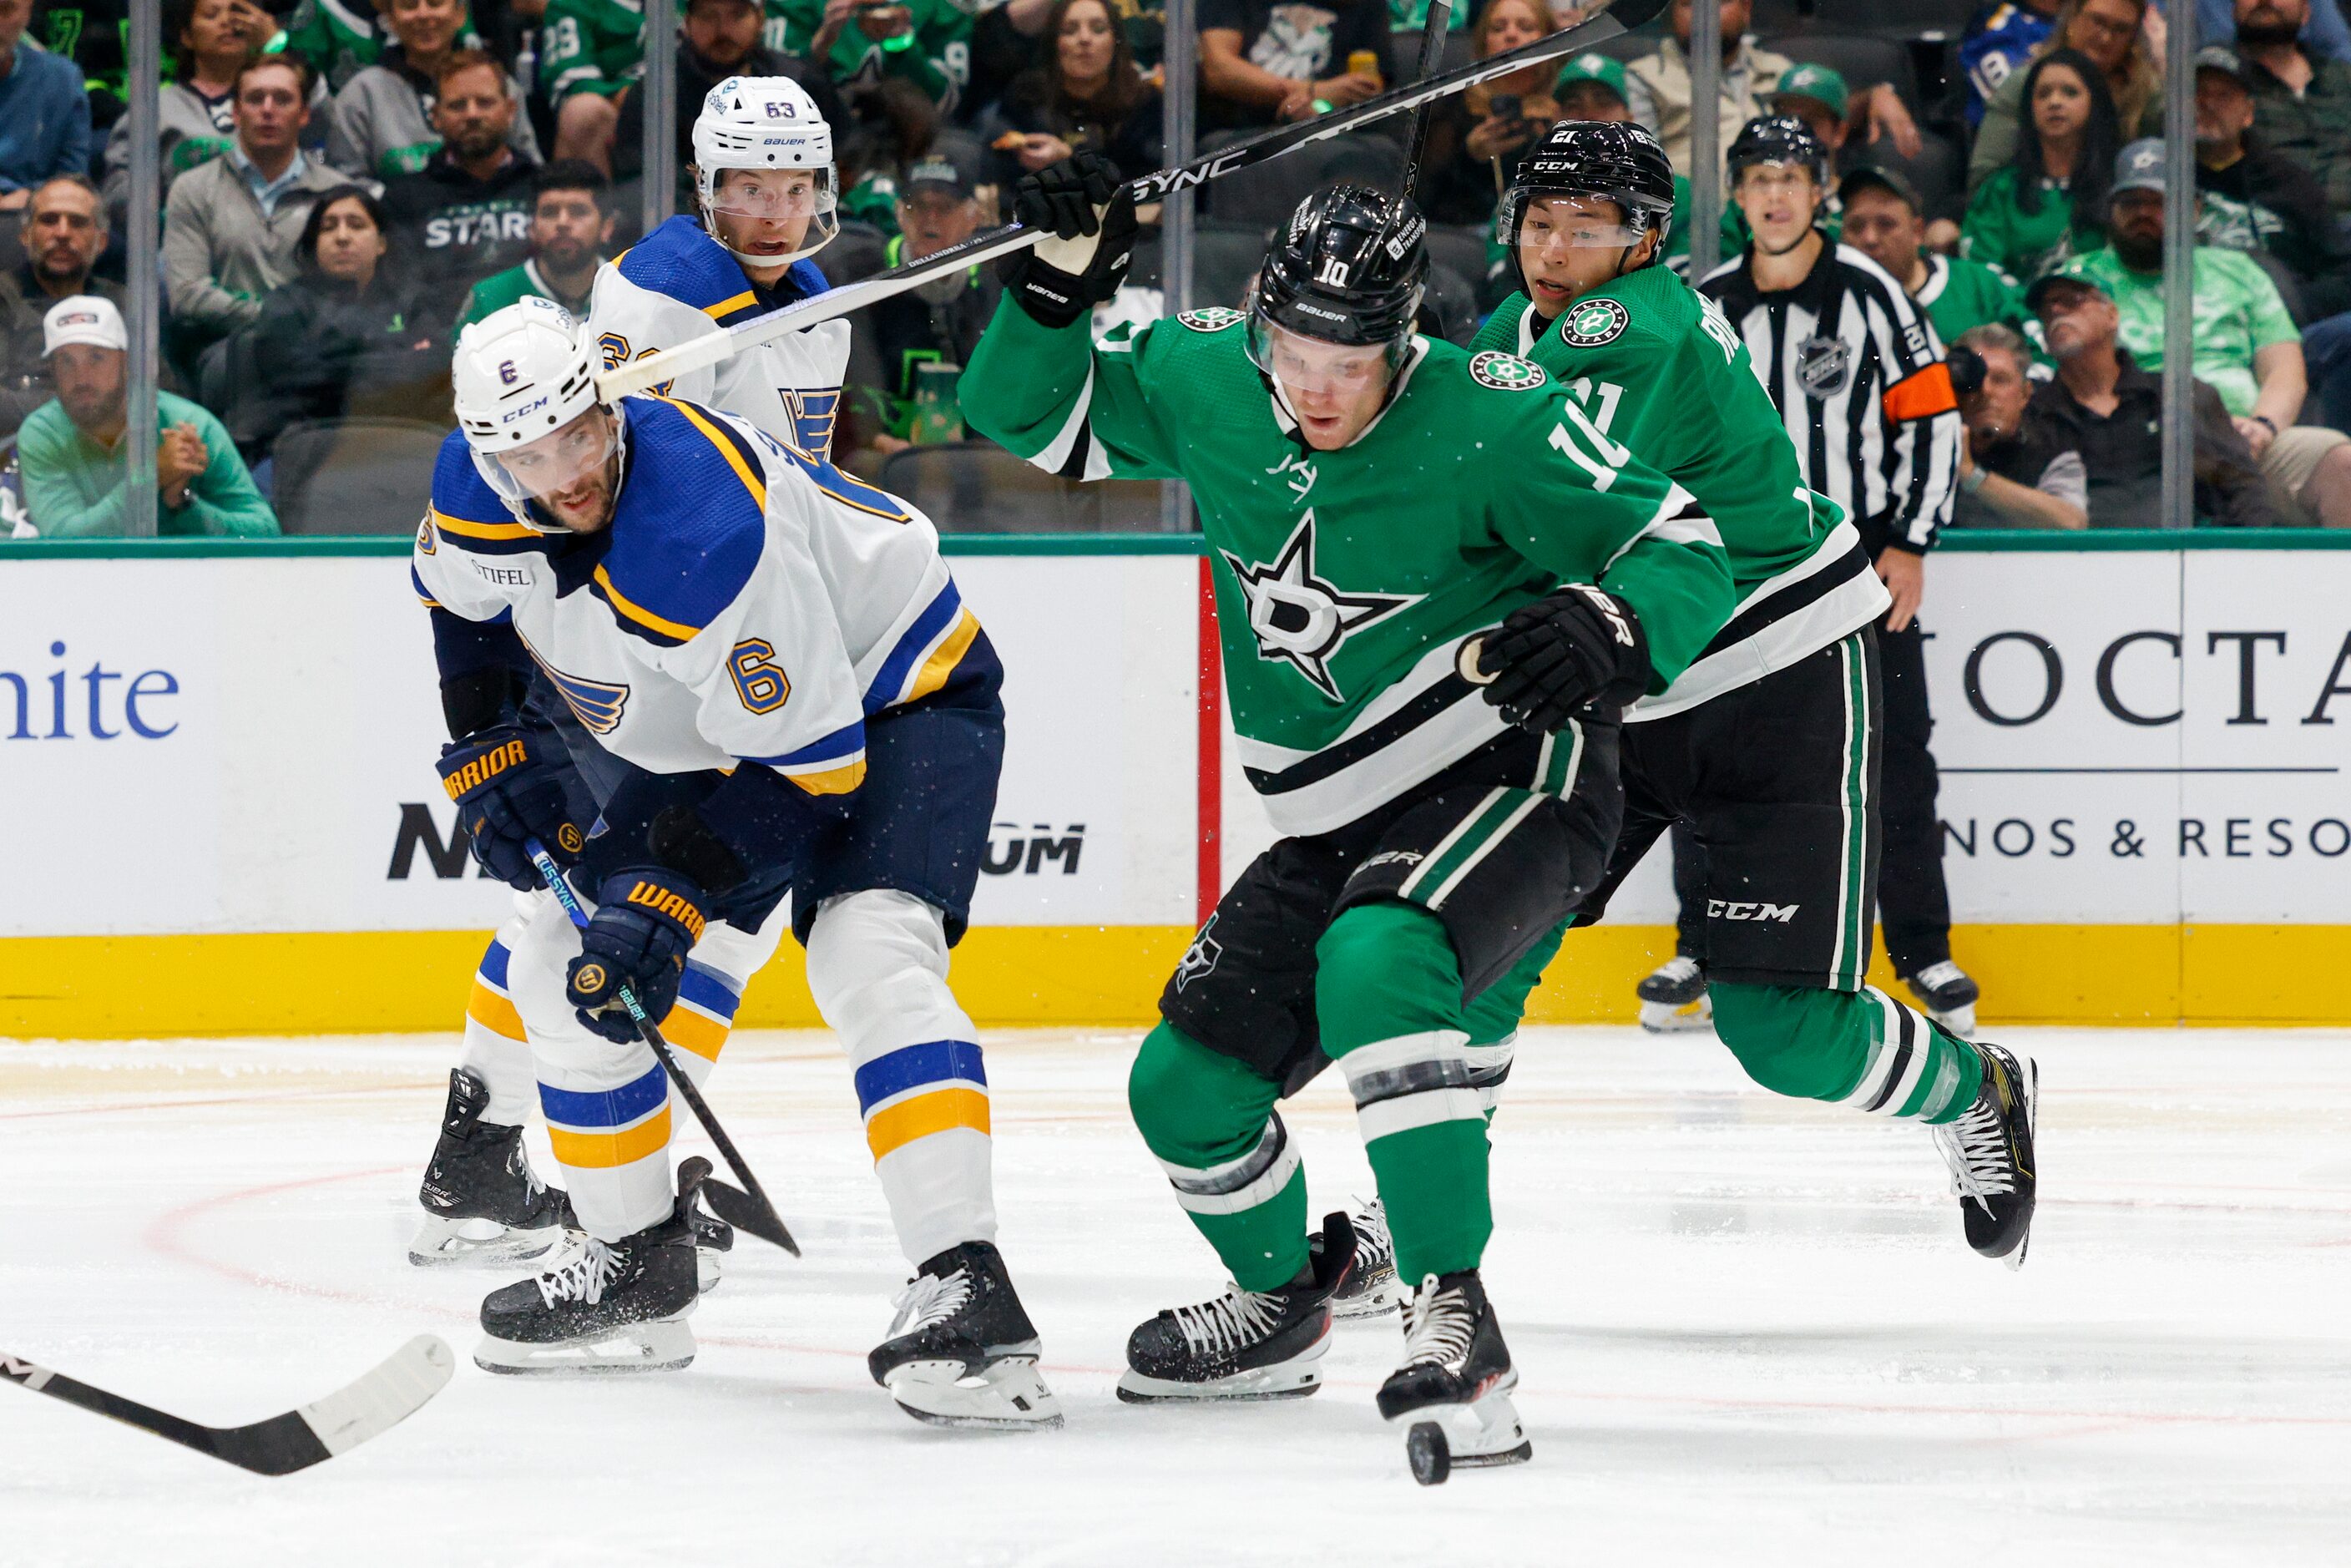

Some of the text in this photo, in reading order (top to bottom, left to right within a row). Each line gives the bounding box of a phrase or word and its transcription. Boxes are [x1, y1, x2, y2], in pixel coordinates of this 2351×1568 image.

[764, 101, 796, 119] 63
[763, 138, 806, 146] BAUER
[1550, 130, 1578, 144] 21
[1134, 149, 1247, 203] SYNC
[1533, 161, 1579, 171] CCM
[425, 210, 533, 248] STAR
[1396, 216, 1418, 243] ENERGY
[1313, 257, 1350, 289] 10
[1026, 281, 1069, 305] BAUER
[1295, 302, 1347, 324] BAUER
[1566, 301, 1622, 328] DALLAS
[1570, 321, 1622, 343] STARS
[503, 397, 549, 424] CCM
[726, 637, 791, 716] 6
[1920, 630, 2351, 726] OCTA
[2111, 818, 2146, 858] &
[2179, 818, 2351, 858] RESO
[547, 873, 579, 917] SYNC
[1706, 898, 1801, 923] CCM
[618, 988, 647, 1022] BAUER
